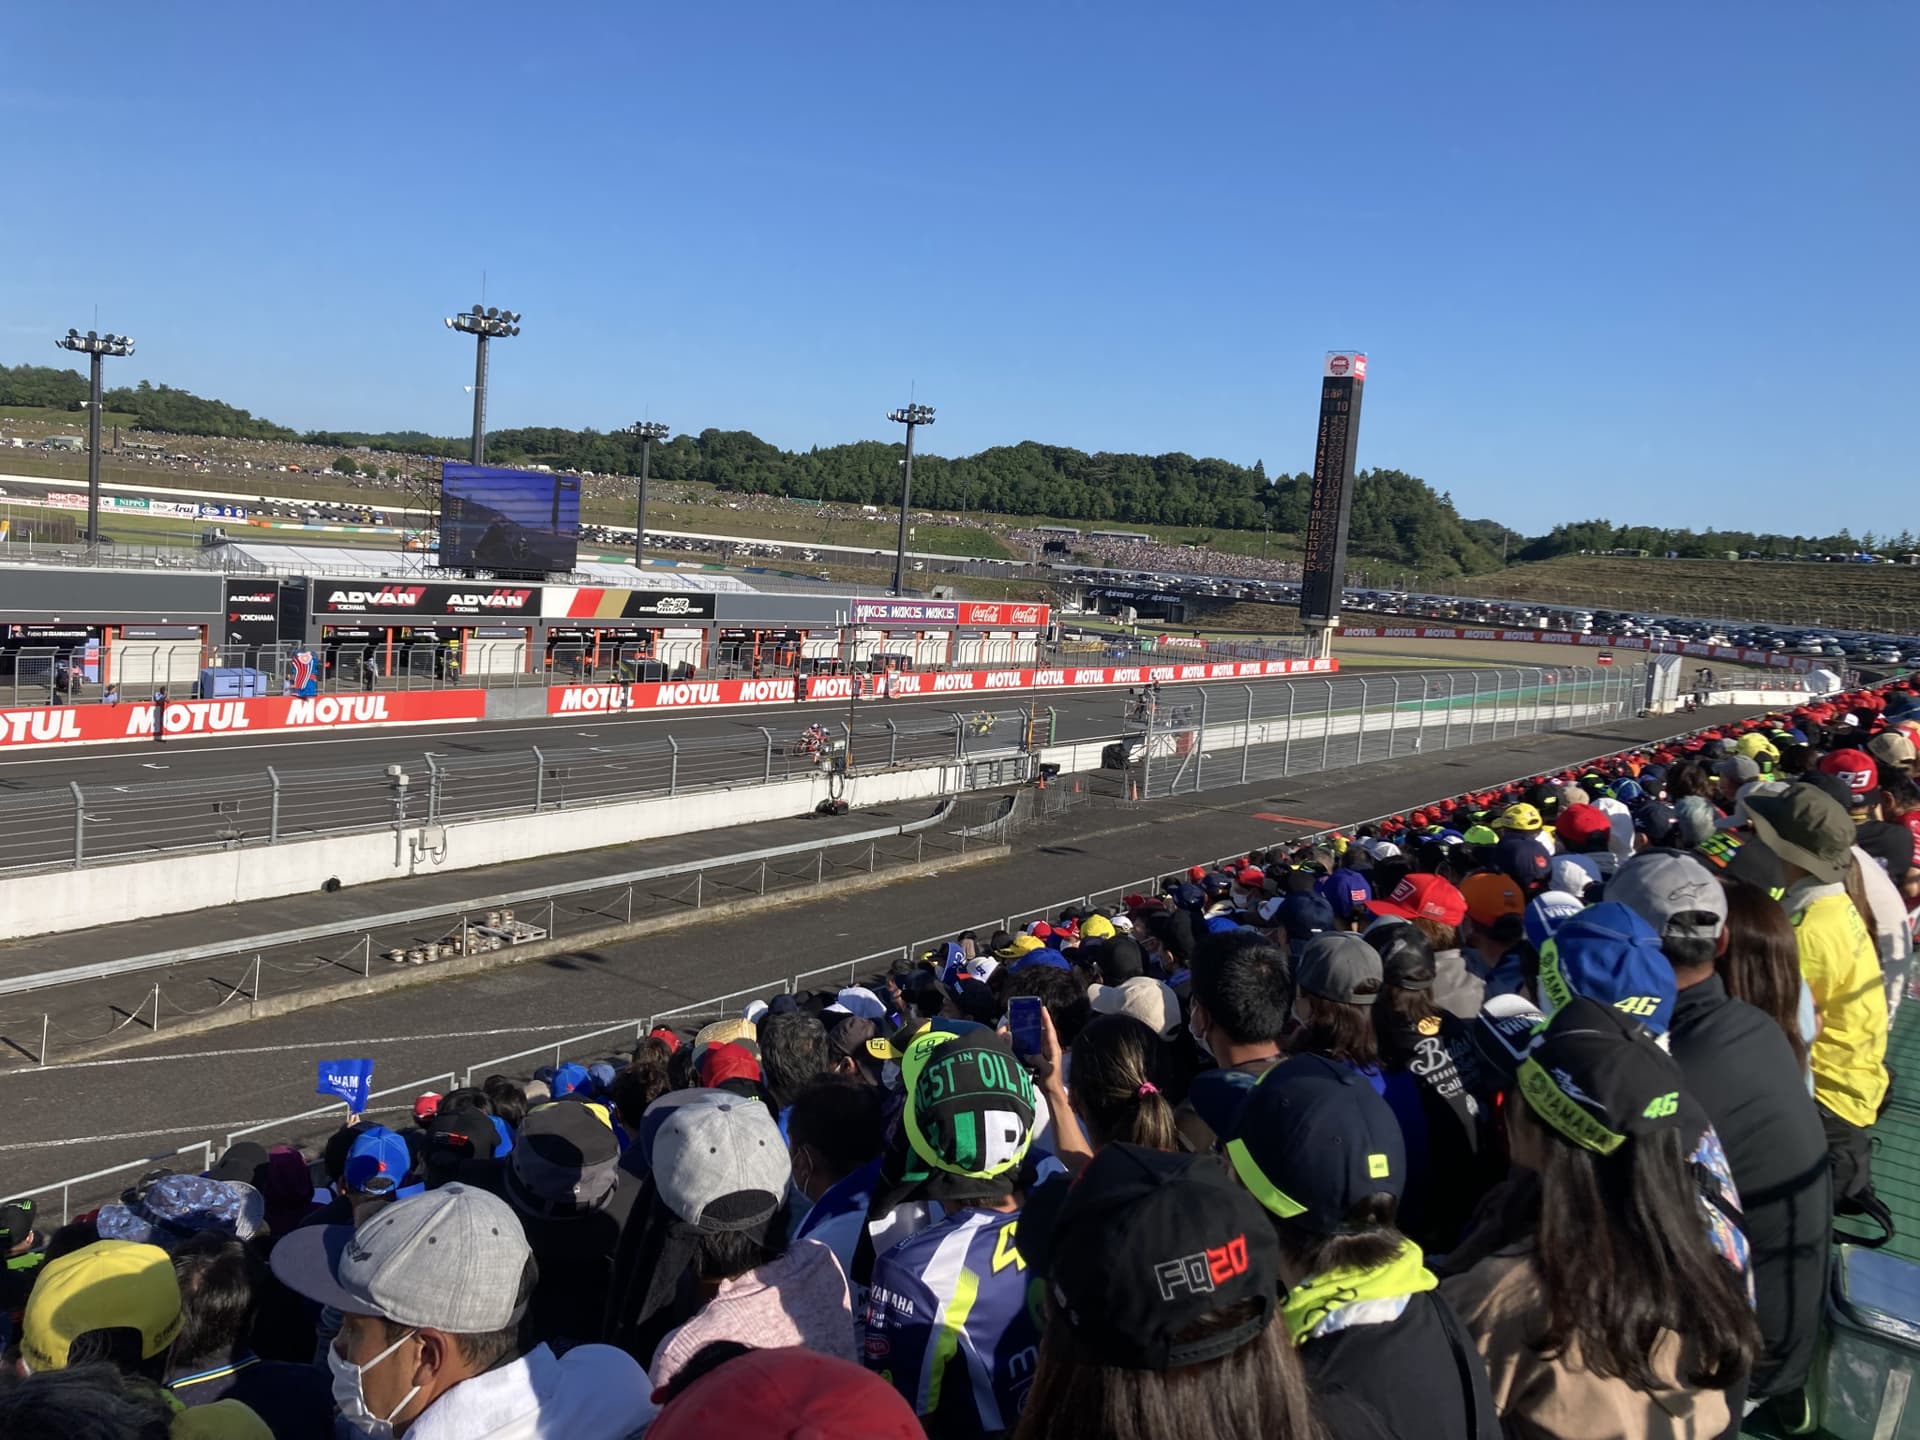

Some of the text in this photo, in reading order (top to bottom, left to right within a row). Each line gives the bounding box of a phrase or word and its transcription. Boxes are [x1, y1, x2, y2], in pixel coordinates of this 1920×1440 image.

[1337, 401, 1348, 411] 10
[120, 499, 145, 507] NIPPO
[168, 504, 194, 514] Arai
[328, 591, 522, 606] ADVAN ADVAN
[240, 614, 274, 622] YOKOHAMA
[1384, 628, 1417, 637] MOTUL
[1424, 628, 1457, 638] MOTUL
[1464, 630, 1496, 639] MOTUL
[1166, 637, 1203, 648] MOTUL
[126, 702, 251, 734] MOTUL
[286, 696, 389, 724] MOTUL
[561, 687, 635, 710] MOTUL
[656, 684, 721, 706] MOTUL
[739, 680, 795, 700] MOTUL
[812, 678, 853, 696] MOTU
[876, 675, 921, 693] MTUL
[934, 672, 974, 690] MOTUL
[985, 670, 1022, 687] MOTUL
[1032, 671, 1064, 685] MOTUL
[1074, 670, 1104, 684] MOTUL
[1112, 668, 1141, 682] MOTUL
[1181, 665, 1206, 679] MOTUL
[1211, 664, 1235, 677] MOTUL
[1239, 662, 1261, 675] MOTUL
[1266, 661, 1287, 673] MOTUL
[1613, 997, 1662, 1017] 46
[958, 1052, 974, 1063] IN
[978, 1052, 1017, 1093] OIL
[1642, 1092, 1679, 1119] 46
[1154, 1233, 1249, 1301] FQ20
[871, 1281, 914, 1315] YAMAHA
